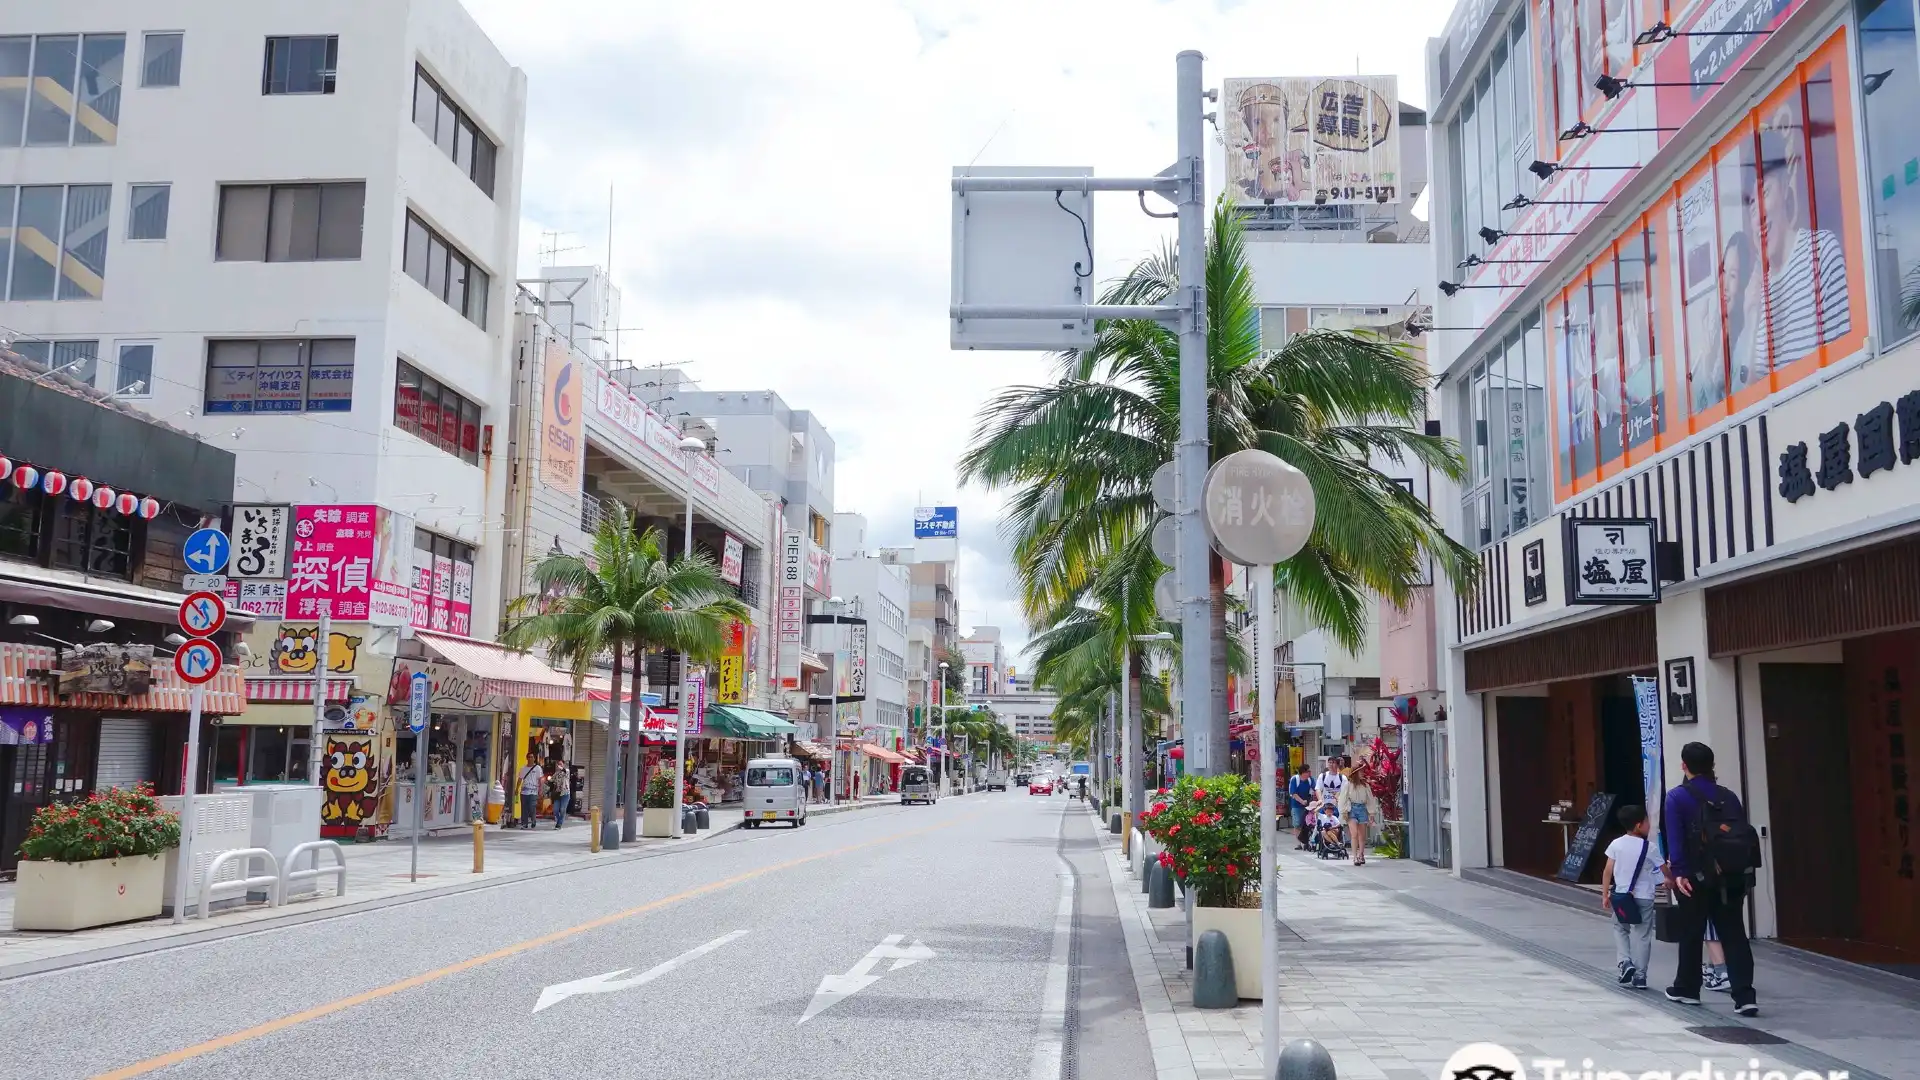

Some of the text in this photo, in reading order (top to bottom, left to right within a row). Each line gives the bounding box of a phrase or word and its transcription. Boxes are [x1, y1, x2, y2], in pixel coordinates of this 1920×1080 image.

[1320, 92, 1363, 116] 広告
[1497, 161, 1592, 298] 女性専用エリア
[258, 381, 300, 391] 沖縄支店
[346, 511, 370, 523] 調査
[1217, 486, 1306, 527] 消火栓
[356, 530, 372, 539] 発見
[915, 520, 956, 530] コスモ不動産
[316, 542, 335, 552] 調査
[786, 535, 799, 580] PIER 88
[290, 555, 371, 594] 探偵
[1582, 557, 1648, 585] 塩屋
[298, 597, 367, 617] 浮気 調査
[722, 658, 731, 700] パイレーツ
[414, 682, 424, 721] 国際通り
[687, 693, 696, 727] カラオケ
